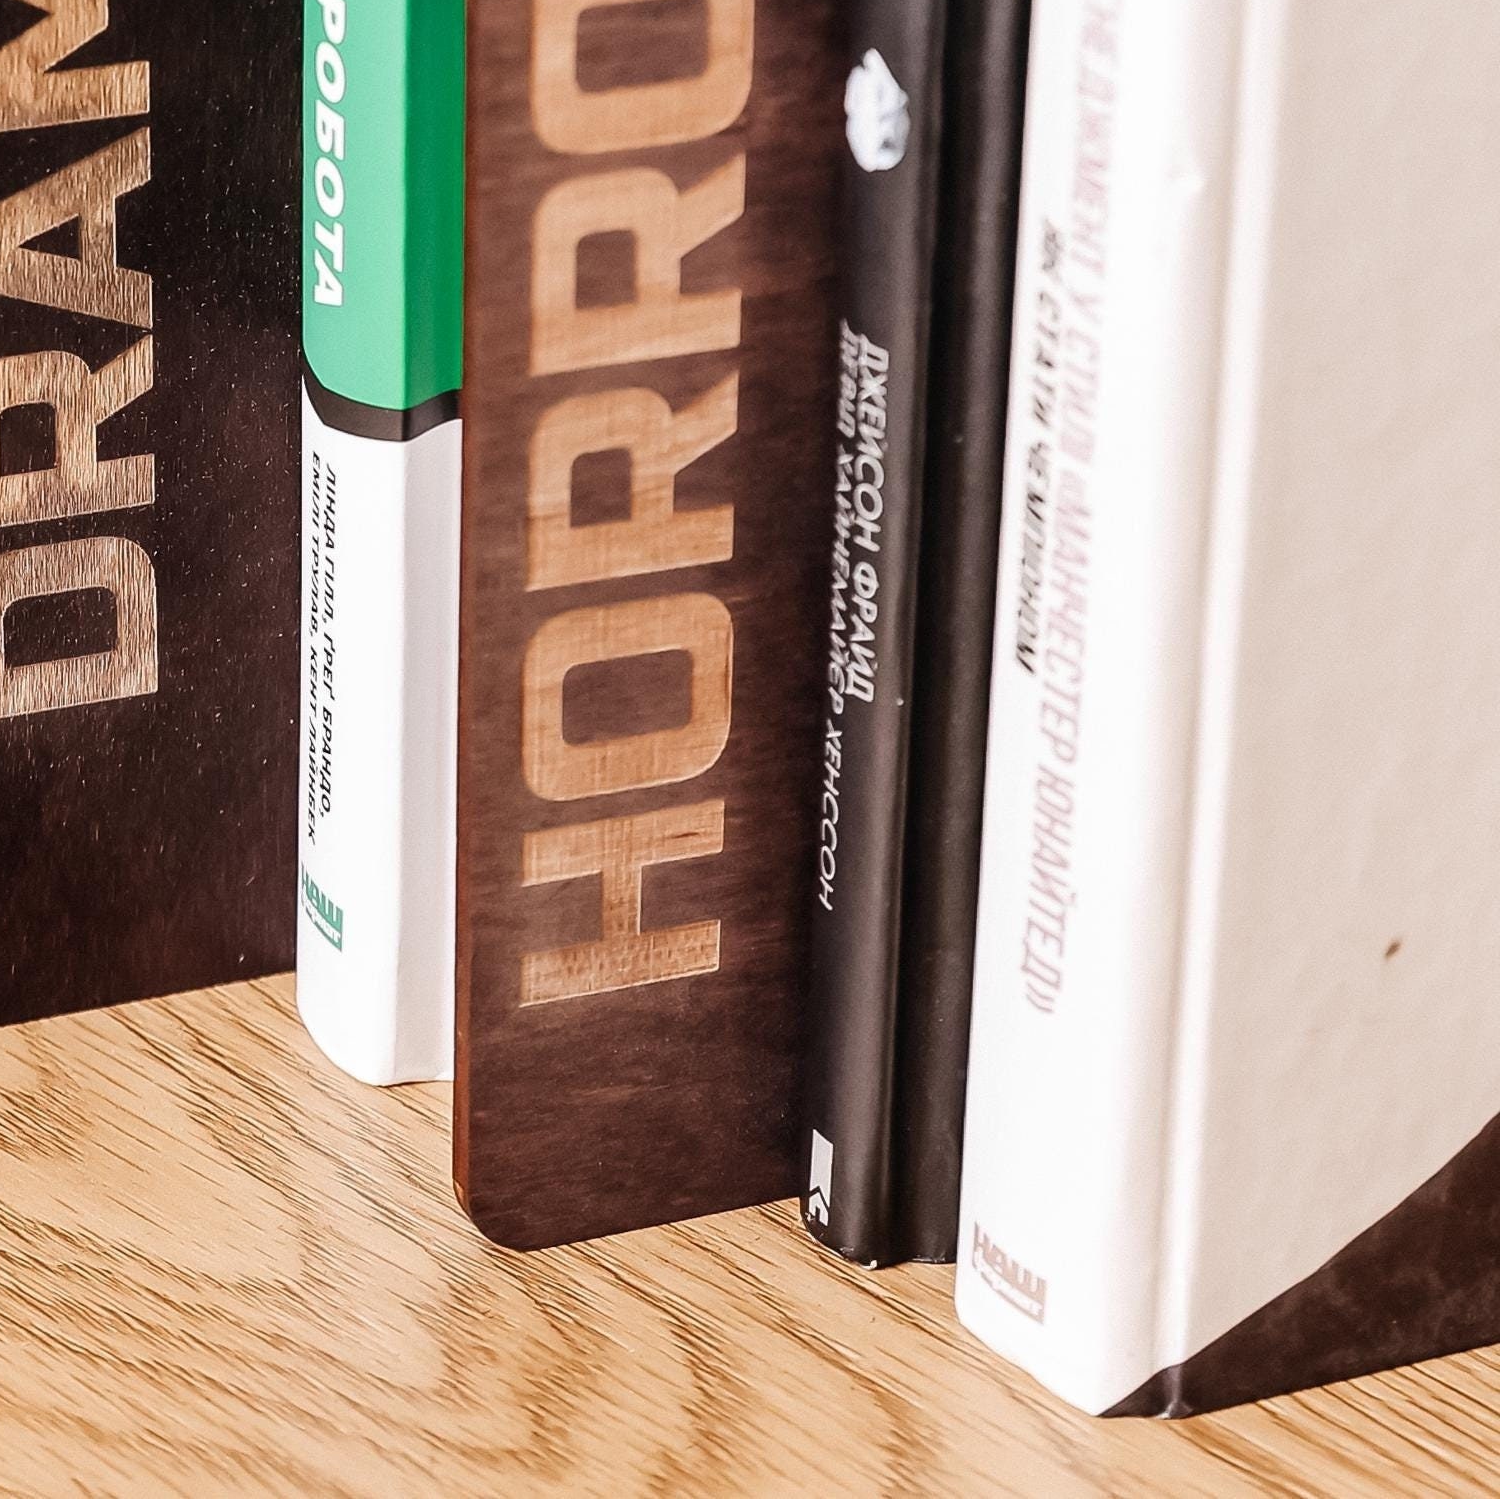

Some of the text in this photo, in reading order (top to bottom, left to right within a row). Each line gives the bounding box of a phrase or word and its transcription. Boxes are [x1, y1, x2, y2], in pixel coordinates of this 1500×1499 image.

[312, 450, 321, 530] ЕМІЛІ
[323, 462, 336, 550] ЛІНДА
[846, 334, 890, 703] ДЖЕЙСОН ФРАЙД
[321, 555, 335, 625] ГІЛЛ,
[310, 645, 318, 718] КЕНТ
[307, 715, 319, 847] ЛАЙНБЕК
[318, 705, 333, 818] БРАНДО,
[819, 718, 843, 911] ХЕНССОН
[1020, 763, 1077, 1014] ЮНАЙТЕД»
